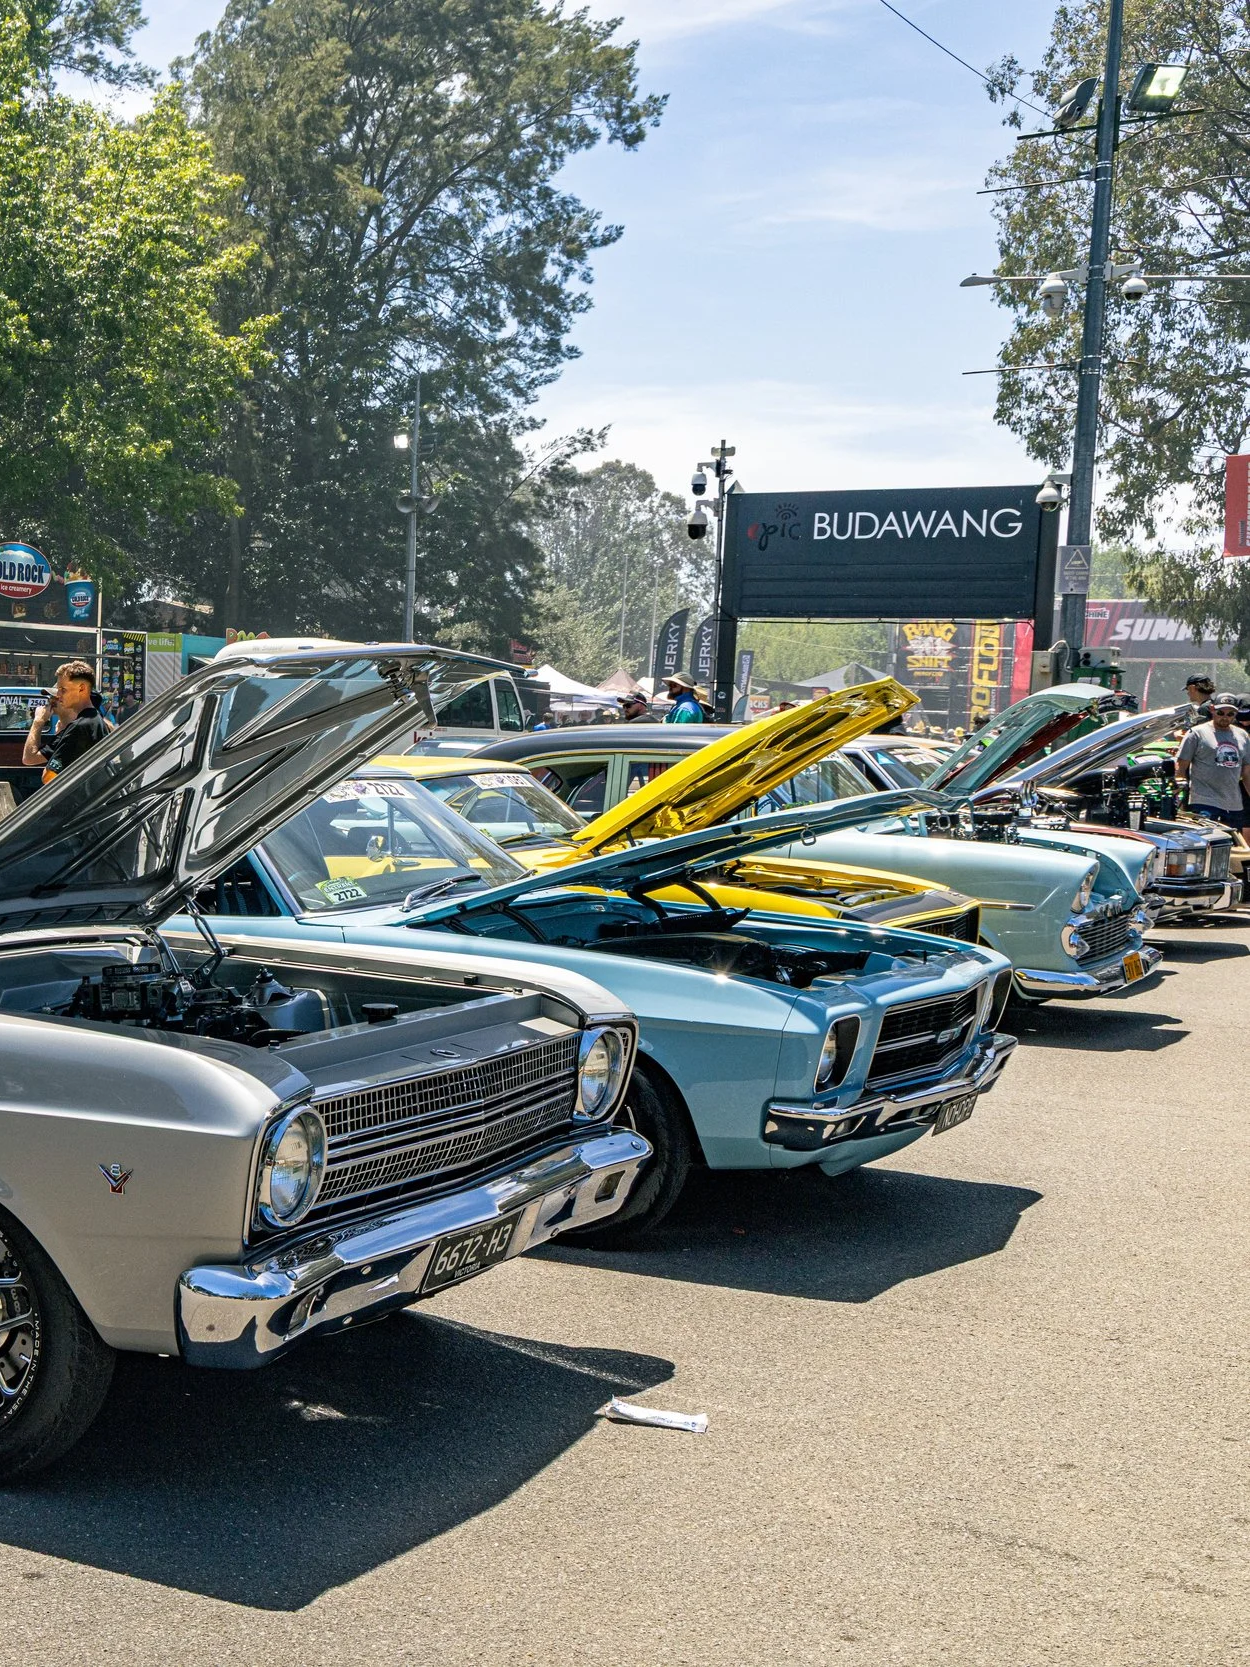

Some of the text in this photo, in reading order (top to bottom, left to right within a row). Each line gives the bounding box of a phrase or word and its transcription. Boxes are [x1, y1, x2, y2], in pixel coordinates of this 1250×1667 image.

[813, 508, 1022, 540] BUDAWANG
[17, 562, 45, 584] ROCK
[9, 585, 32, 594] creamery
[664, 623, 680, 675] JERKY
[698, 626, 713, 676] JERKY
[907, 656, 953, 669] SHIFT
[367, 782, 405, 796] 2722
[334, 889, 362, 901] 2722
[30, 1359, 37, 1372] IN
[21, 1374, 34, 1396] THE
[7, 1397, 23, 1416] USA
